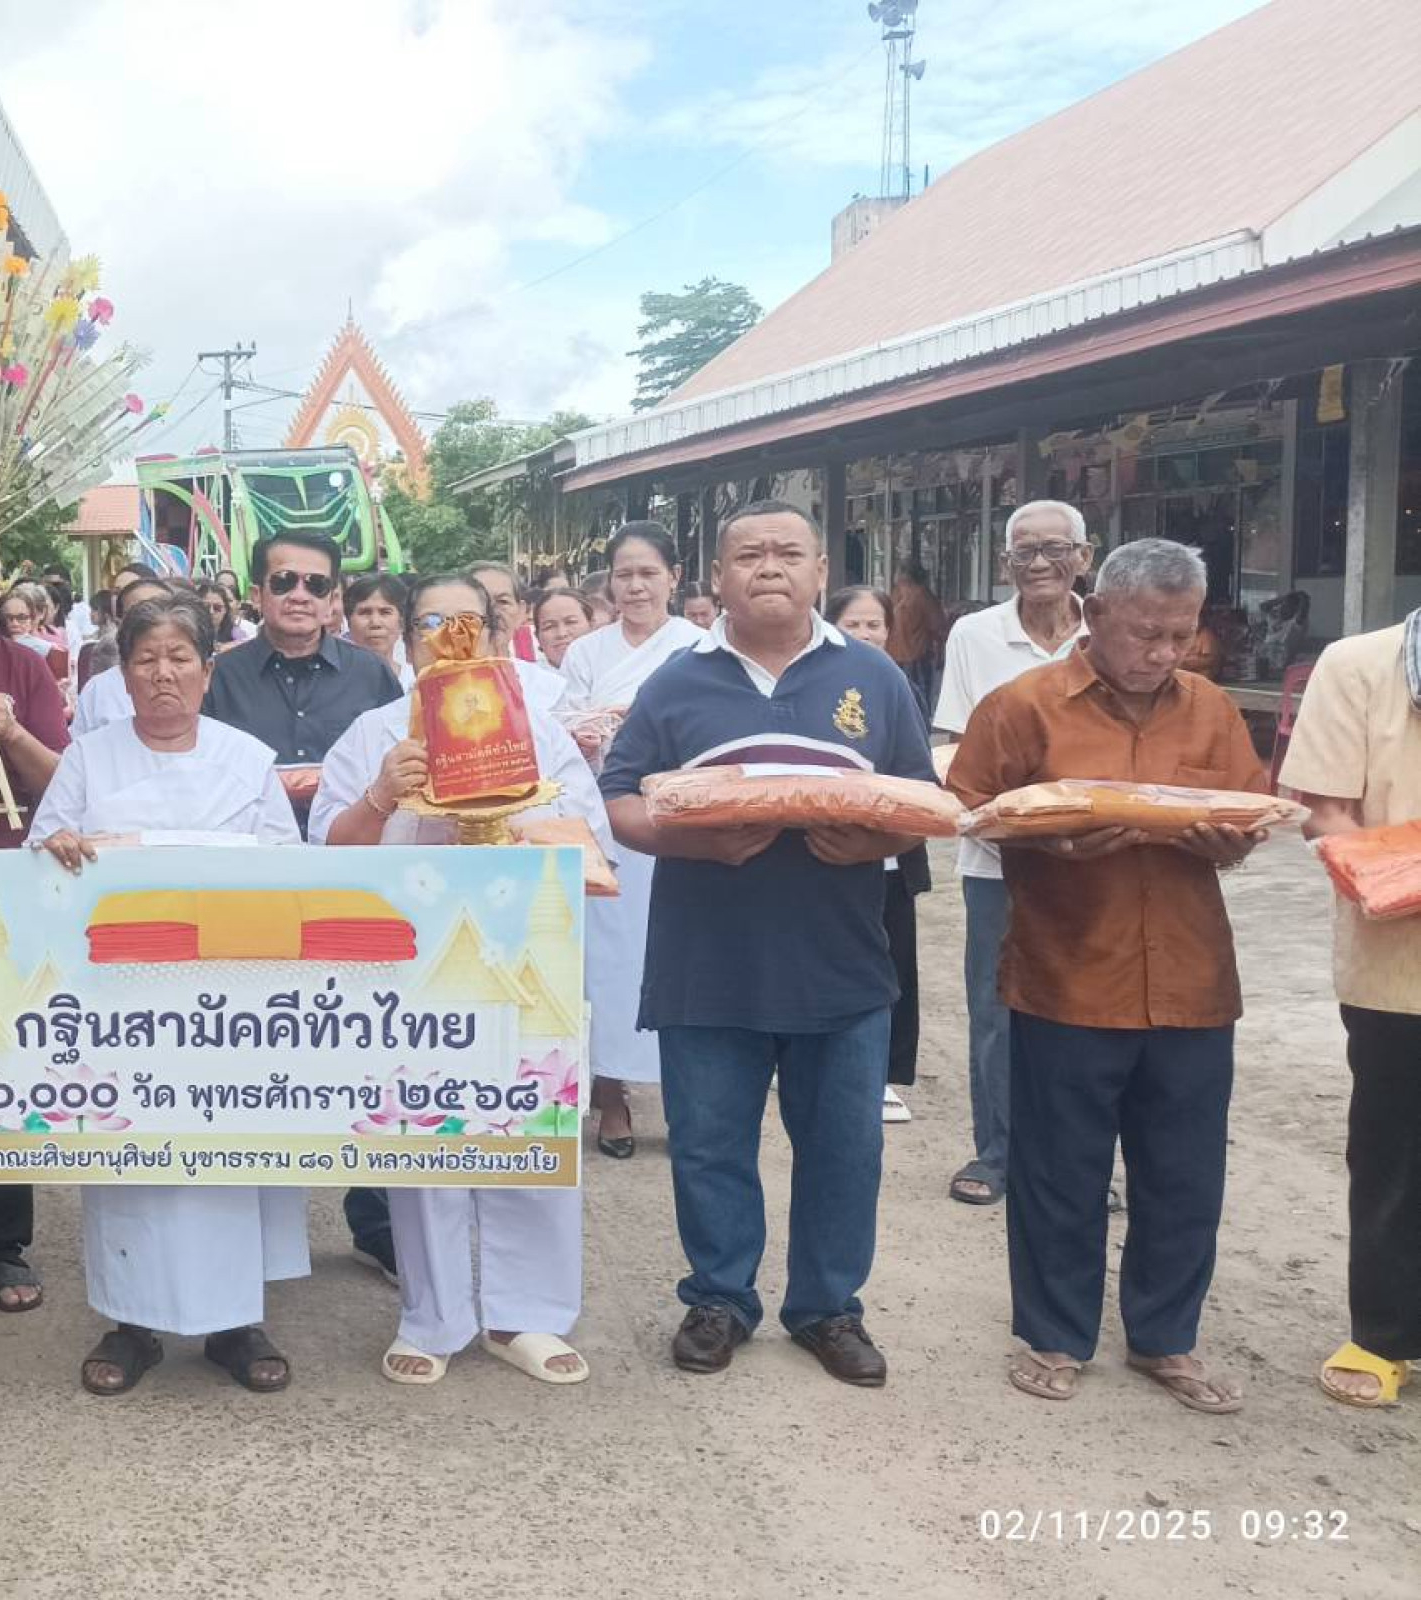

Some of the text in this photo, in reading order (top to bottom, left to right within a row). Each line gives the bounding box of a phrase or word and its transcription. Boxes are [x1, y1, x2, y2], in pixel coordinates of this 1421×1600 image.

[15, 976, 476, 1064] กฐินสามัคคีทั่วไทย
[132, 1072, 176, 1108] วัด
[187, 1073, 381, 1122] พุทธศักราช
[397, 1077, 539, 1111] ๒๕๖๘
[179, 1150, 290, 1177] บูชาธรรม
[299, 1153, 333, 1169] ๘๑
[341, 1144, 359, 1169] ปี
[366, 1145, 558, 1171] หลวงพ่อธัมมชโย
